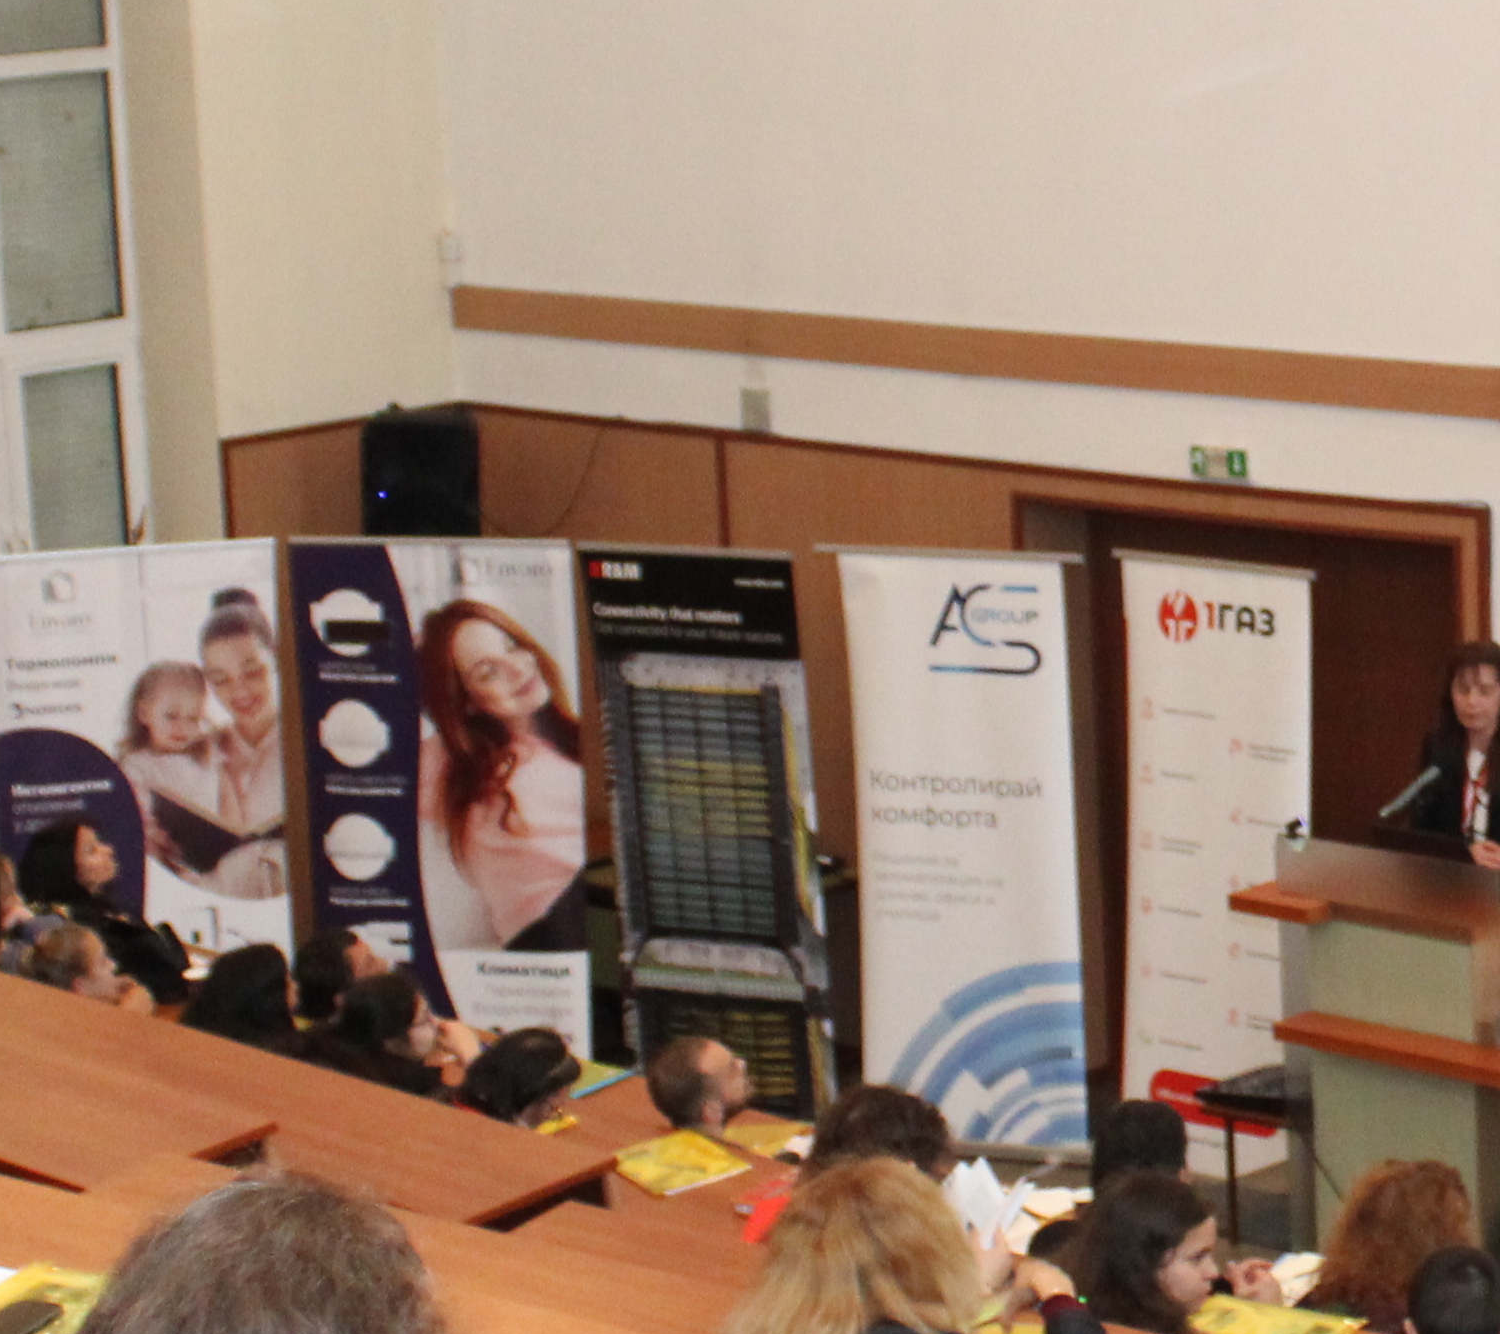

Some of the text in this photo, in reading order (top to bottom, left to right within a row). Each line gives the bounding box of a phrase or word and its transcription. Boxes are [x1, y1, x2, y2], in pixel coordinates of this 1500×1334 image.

[1204, 601, 1275, 637] 1ГАЗ
[870, 769, 1043, 800] Контролирай
[871, 805, 998, 831] комфорта
